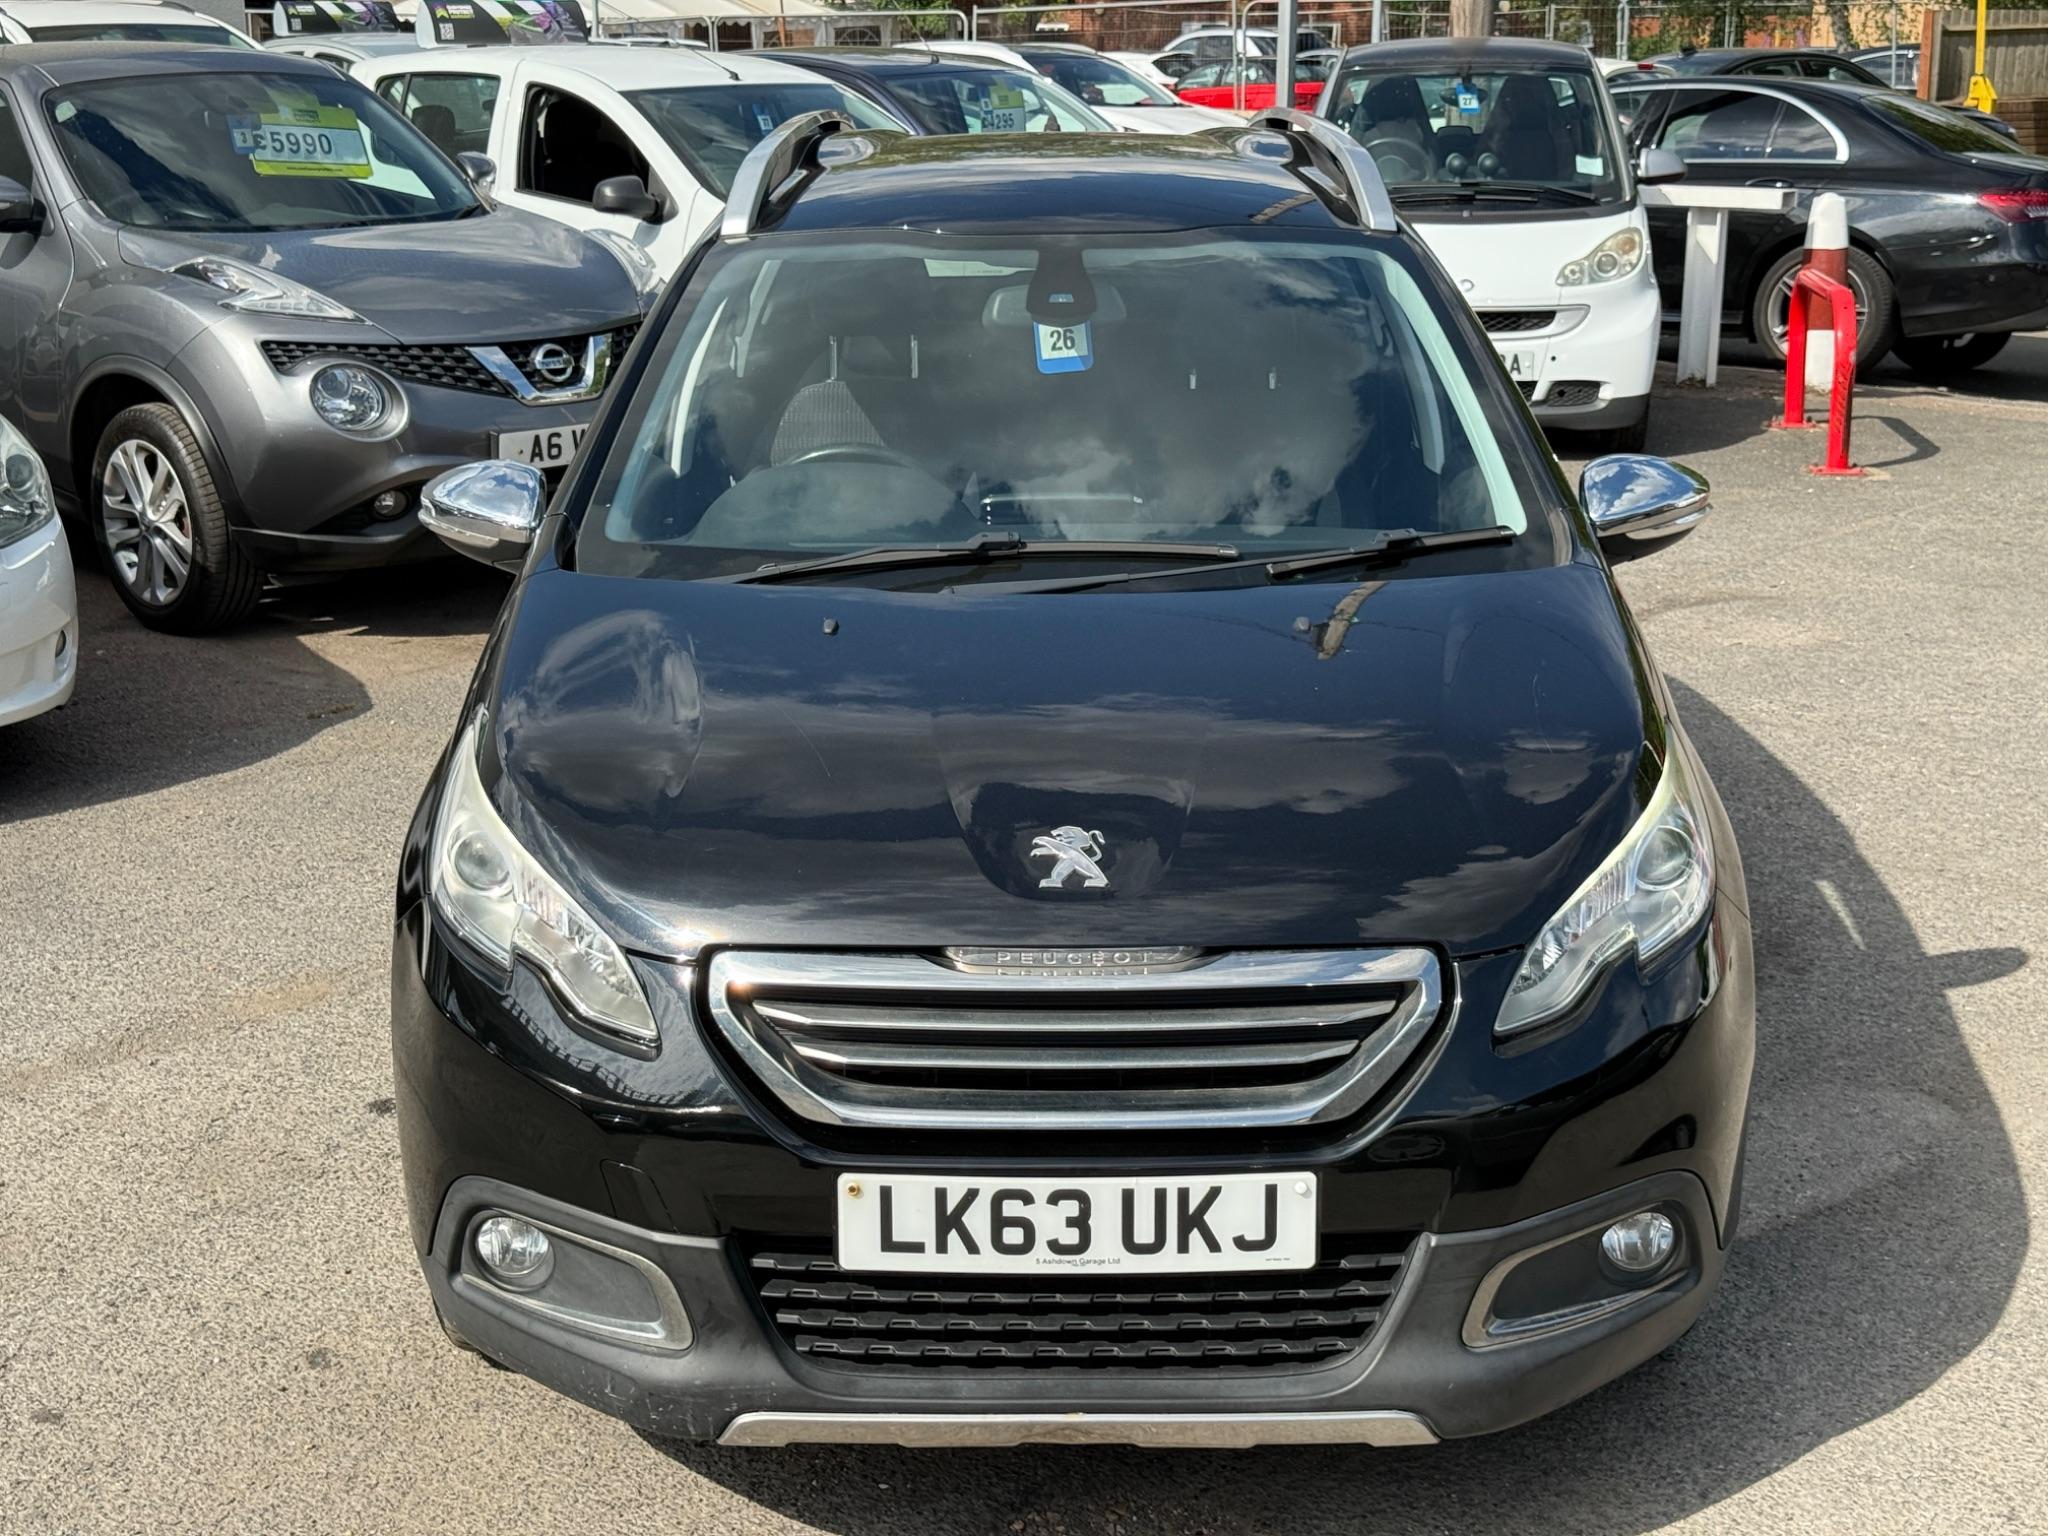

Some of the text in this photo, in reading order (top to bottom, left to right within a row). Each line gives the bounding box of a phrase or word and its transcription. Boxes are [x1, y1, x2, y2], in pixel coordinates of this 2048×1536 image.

[252, 131, 332, 156] £5990
[1050, 328, 1076, 351] 26
[530, 431, 562, 464] A6
[996, 951, 1153, 965] PEUGEOT
[879, 1183, 1278, 1256] LK63 UKJ
[1079, 1258, 1106, 1267] Garage
[1107, 1257, 1121, 1265] Ltd
